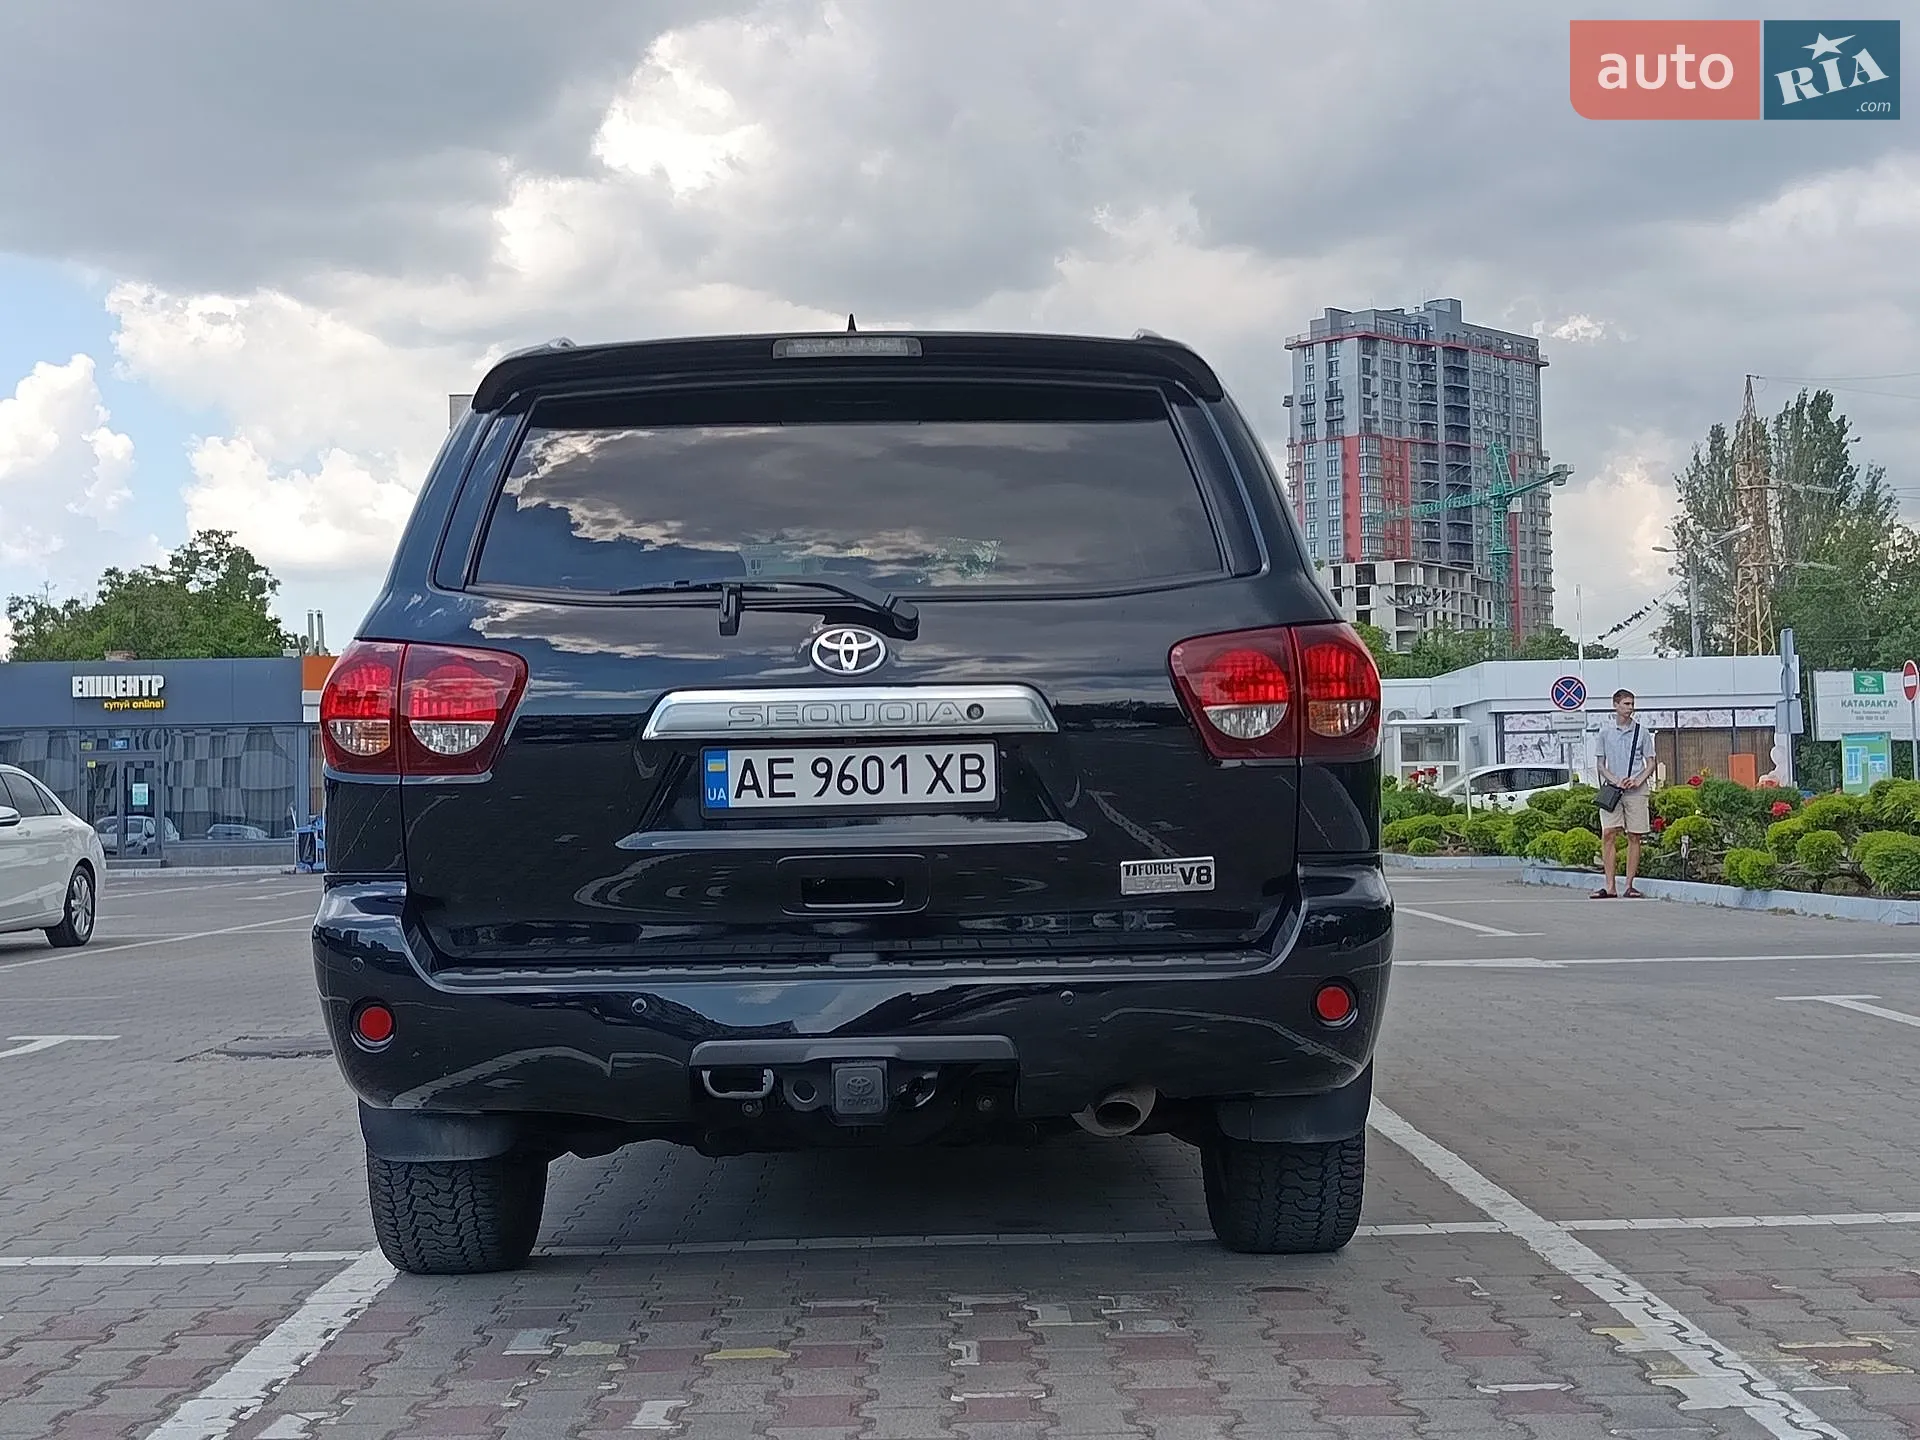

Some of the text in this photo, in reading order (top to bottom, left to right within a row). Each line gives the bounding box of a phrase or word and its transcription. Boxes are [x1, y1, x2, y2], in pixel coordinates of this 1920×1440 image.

[72, 675, 164, 699] ЕПІЦЕНТР
[103, 699, 165, 711] купуй online!
[728, 701, 968, 727] SEQUOIA
[734, 752, 987, 799] AE 9601 XB
[708, 787, 727, 801] UA
[1179, 865, 1213, 886] V8
